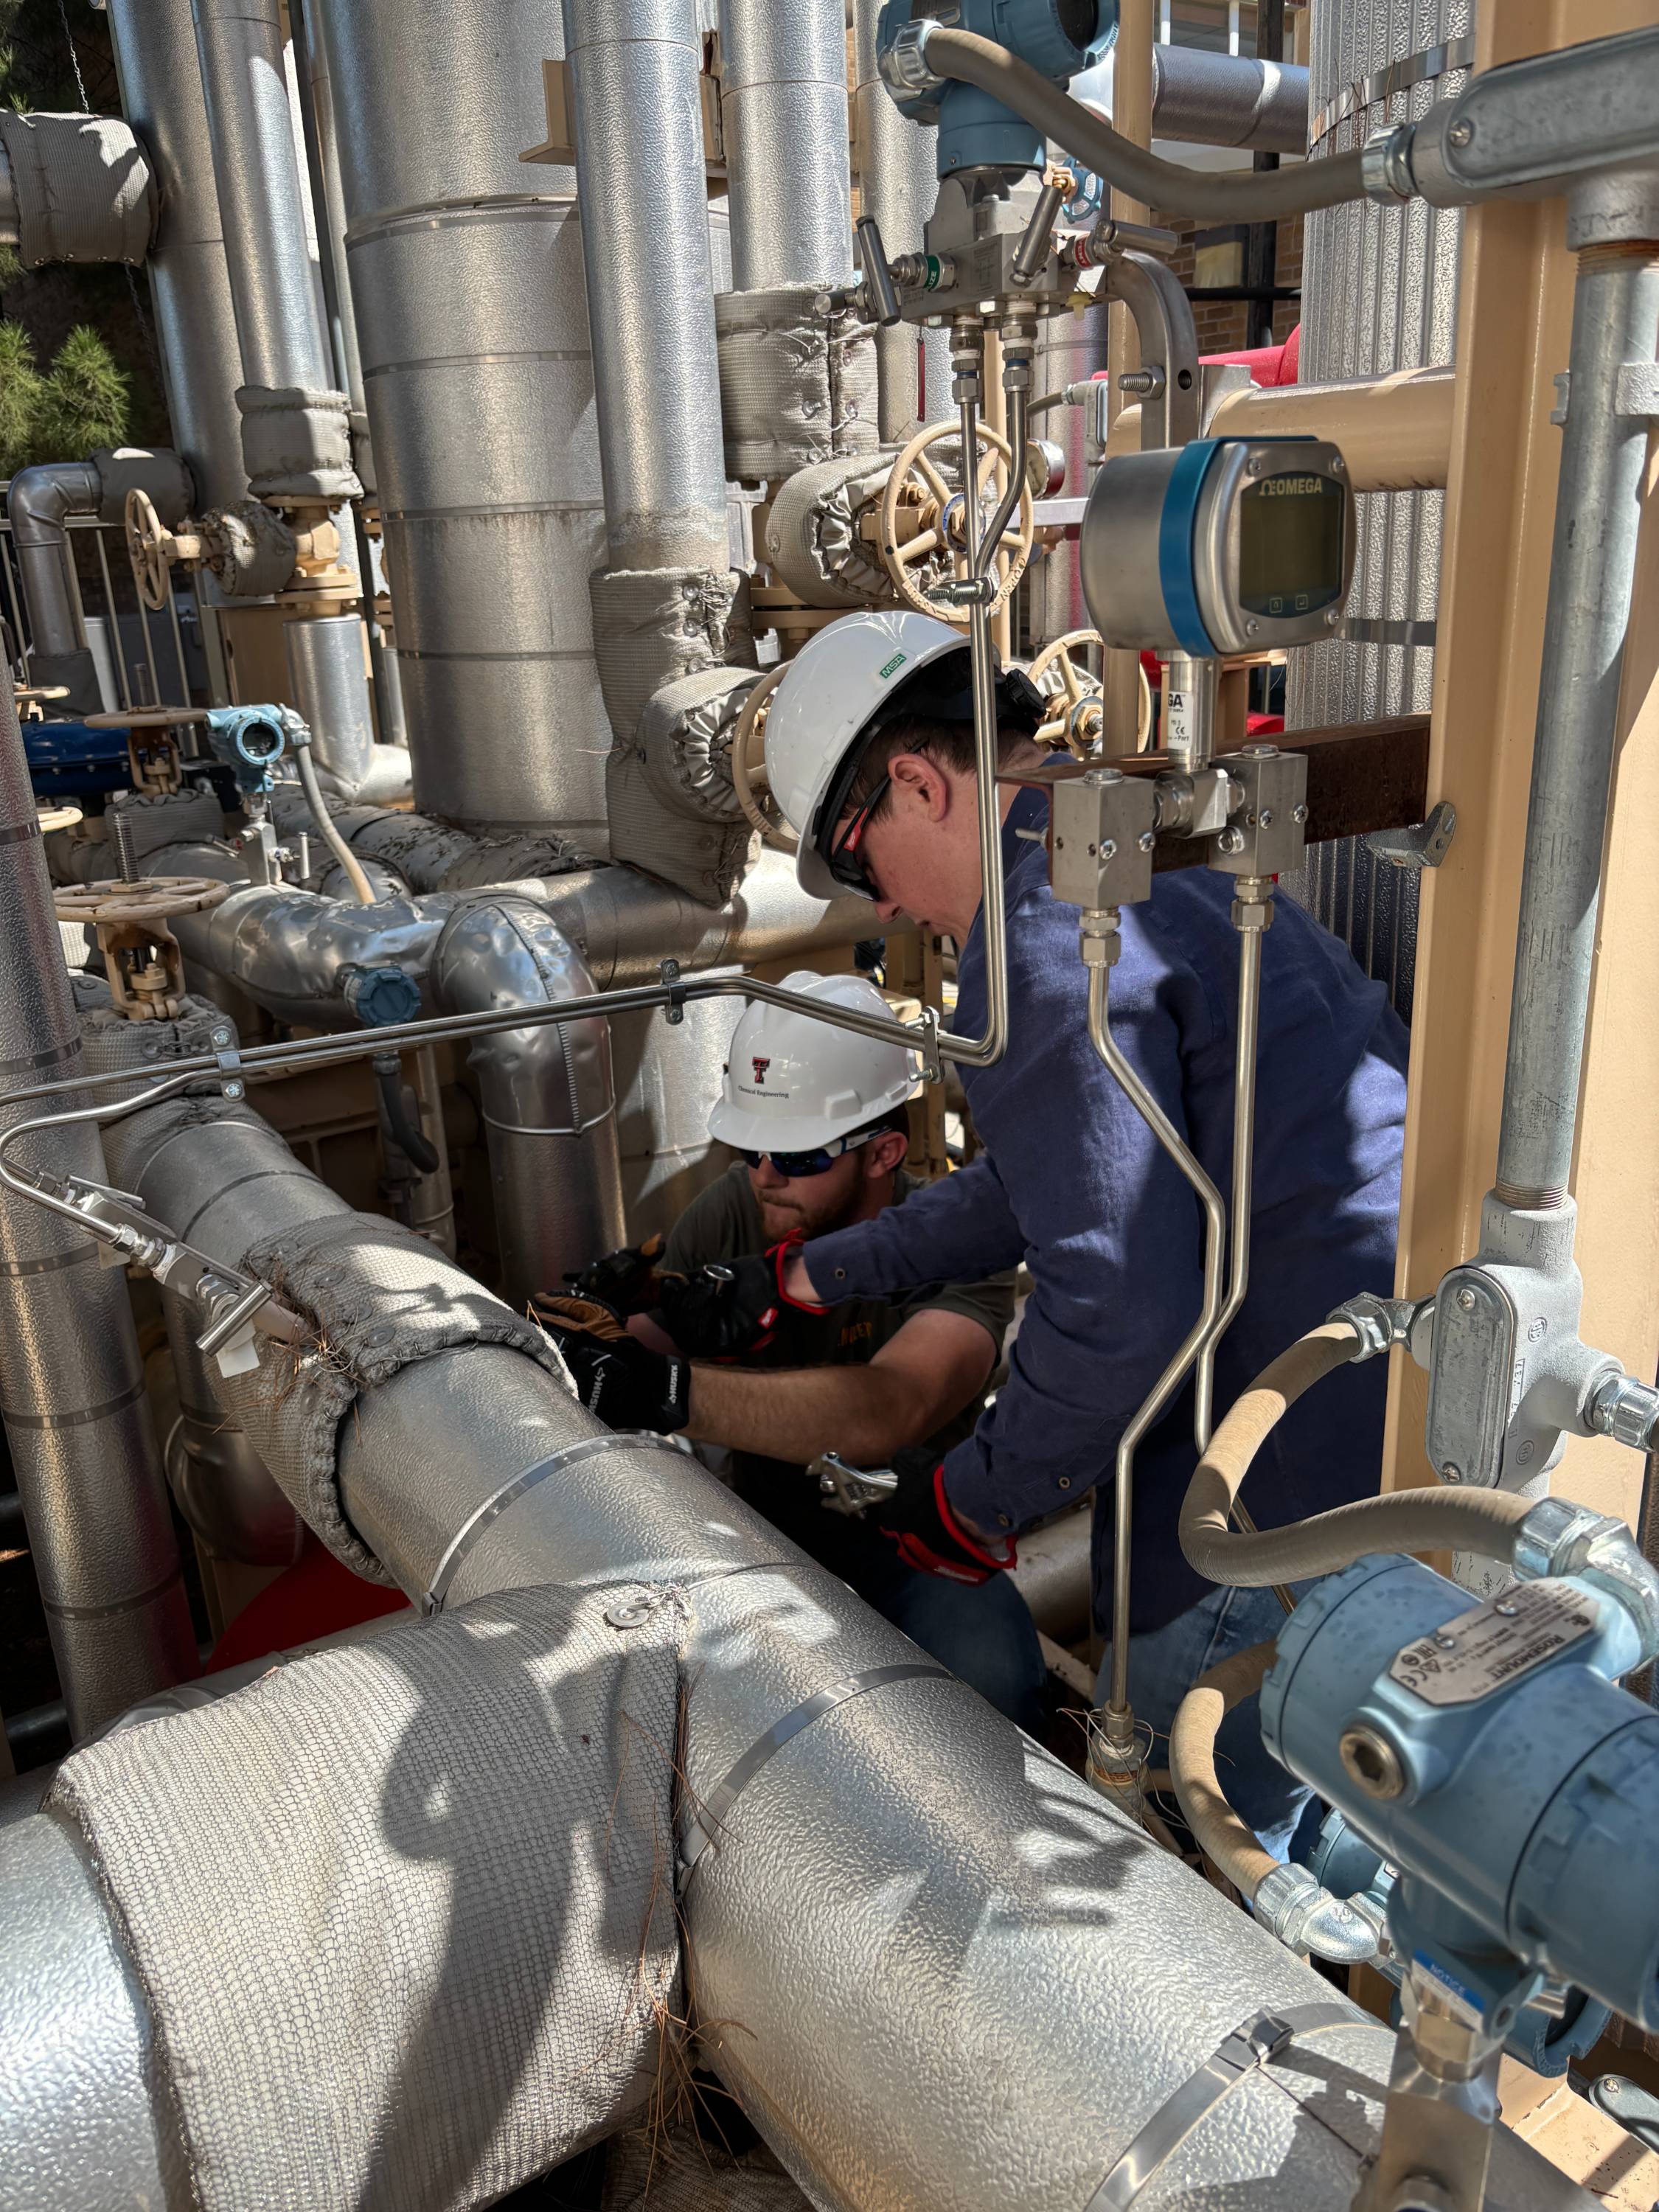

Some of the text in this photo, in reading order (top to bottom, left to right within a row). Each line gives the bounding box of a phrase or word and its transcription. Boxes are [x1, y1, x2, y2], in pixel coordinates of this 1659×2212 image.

[1276, 477, 1322, 495] OMEGA
[882, 655, 905, 677] MSA
[1168, 693, 1183, 708] GA
[757, 1090, 790, 1099] Engineering
[589, 1381, 603, 1413] HUSK
[1489, 1634, 1566, 1681] ROSEMOUNT
